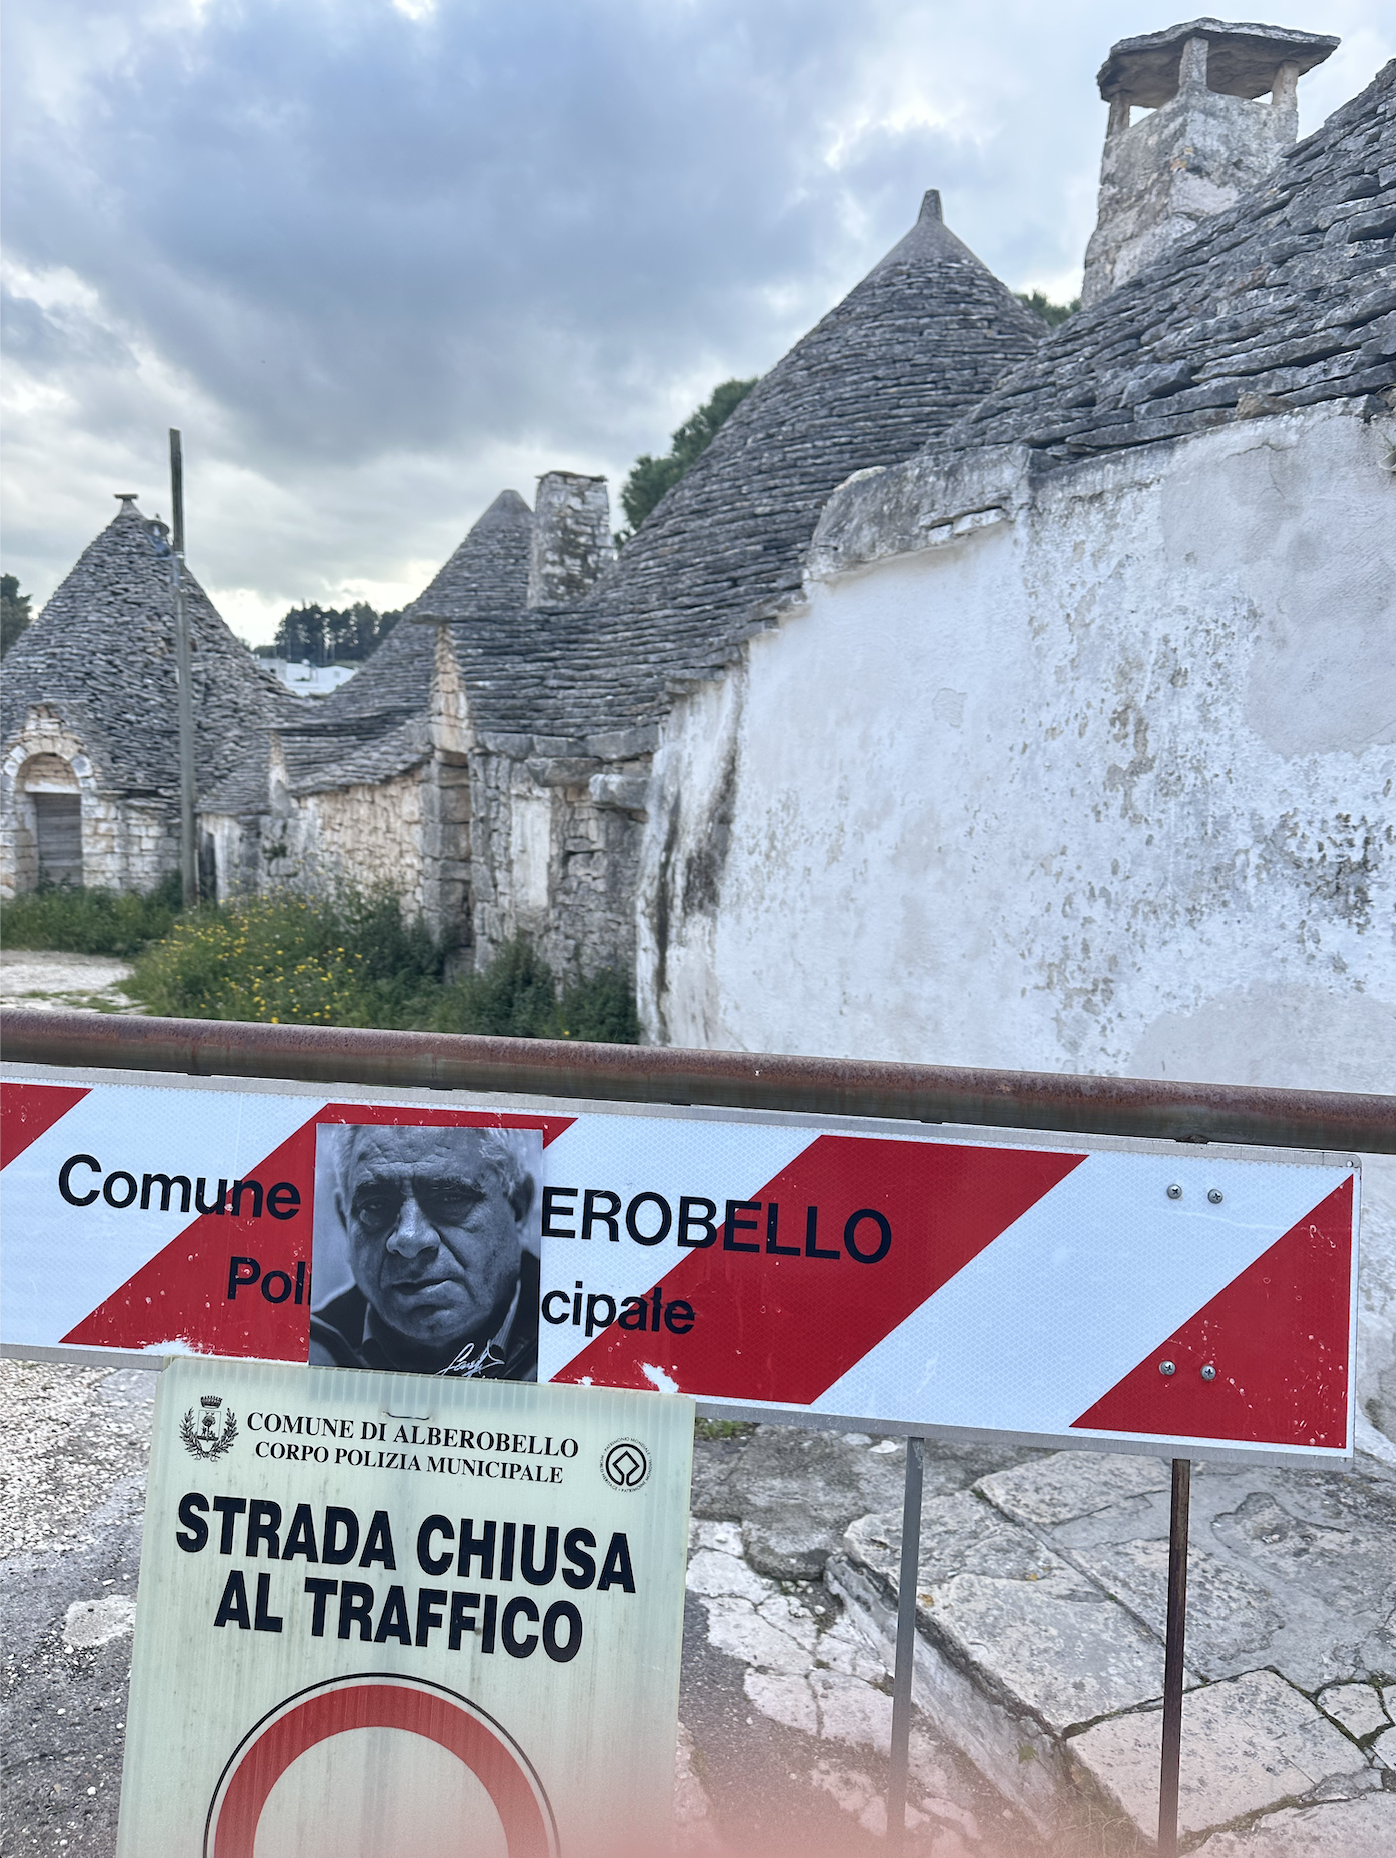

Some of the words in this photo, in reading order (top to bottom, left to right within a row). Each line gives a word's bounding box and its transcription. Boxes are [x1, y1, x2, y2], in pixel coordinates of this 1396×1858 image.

[58, 1154, 301, 1221] Comune
[246, 1411, 355, 1439] COMUNE
[360, 1420, 388, 1442] DI
[392, 1424, 579, 1459] ALBEROBELLO
[255, 1440, 330, 1464] CORPO
[334, 1447, 422, 1472] POLIZIA
[426, 1455, 564, 1484] MUNICIPALE
[175, 1492, 397, 1571] STRADA
[416, 1514, 637, 1594] CHIUSA
[213, 1569, 284, 1634] AL
[303, 1576, 584, 1664] TRAFFICO
